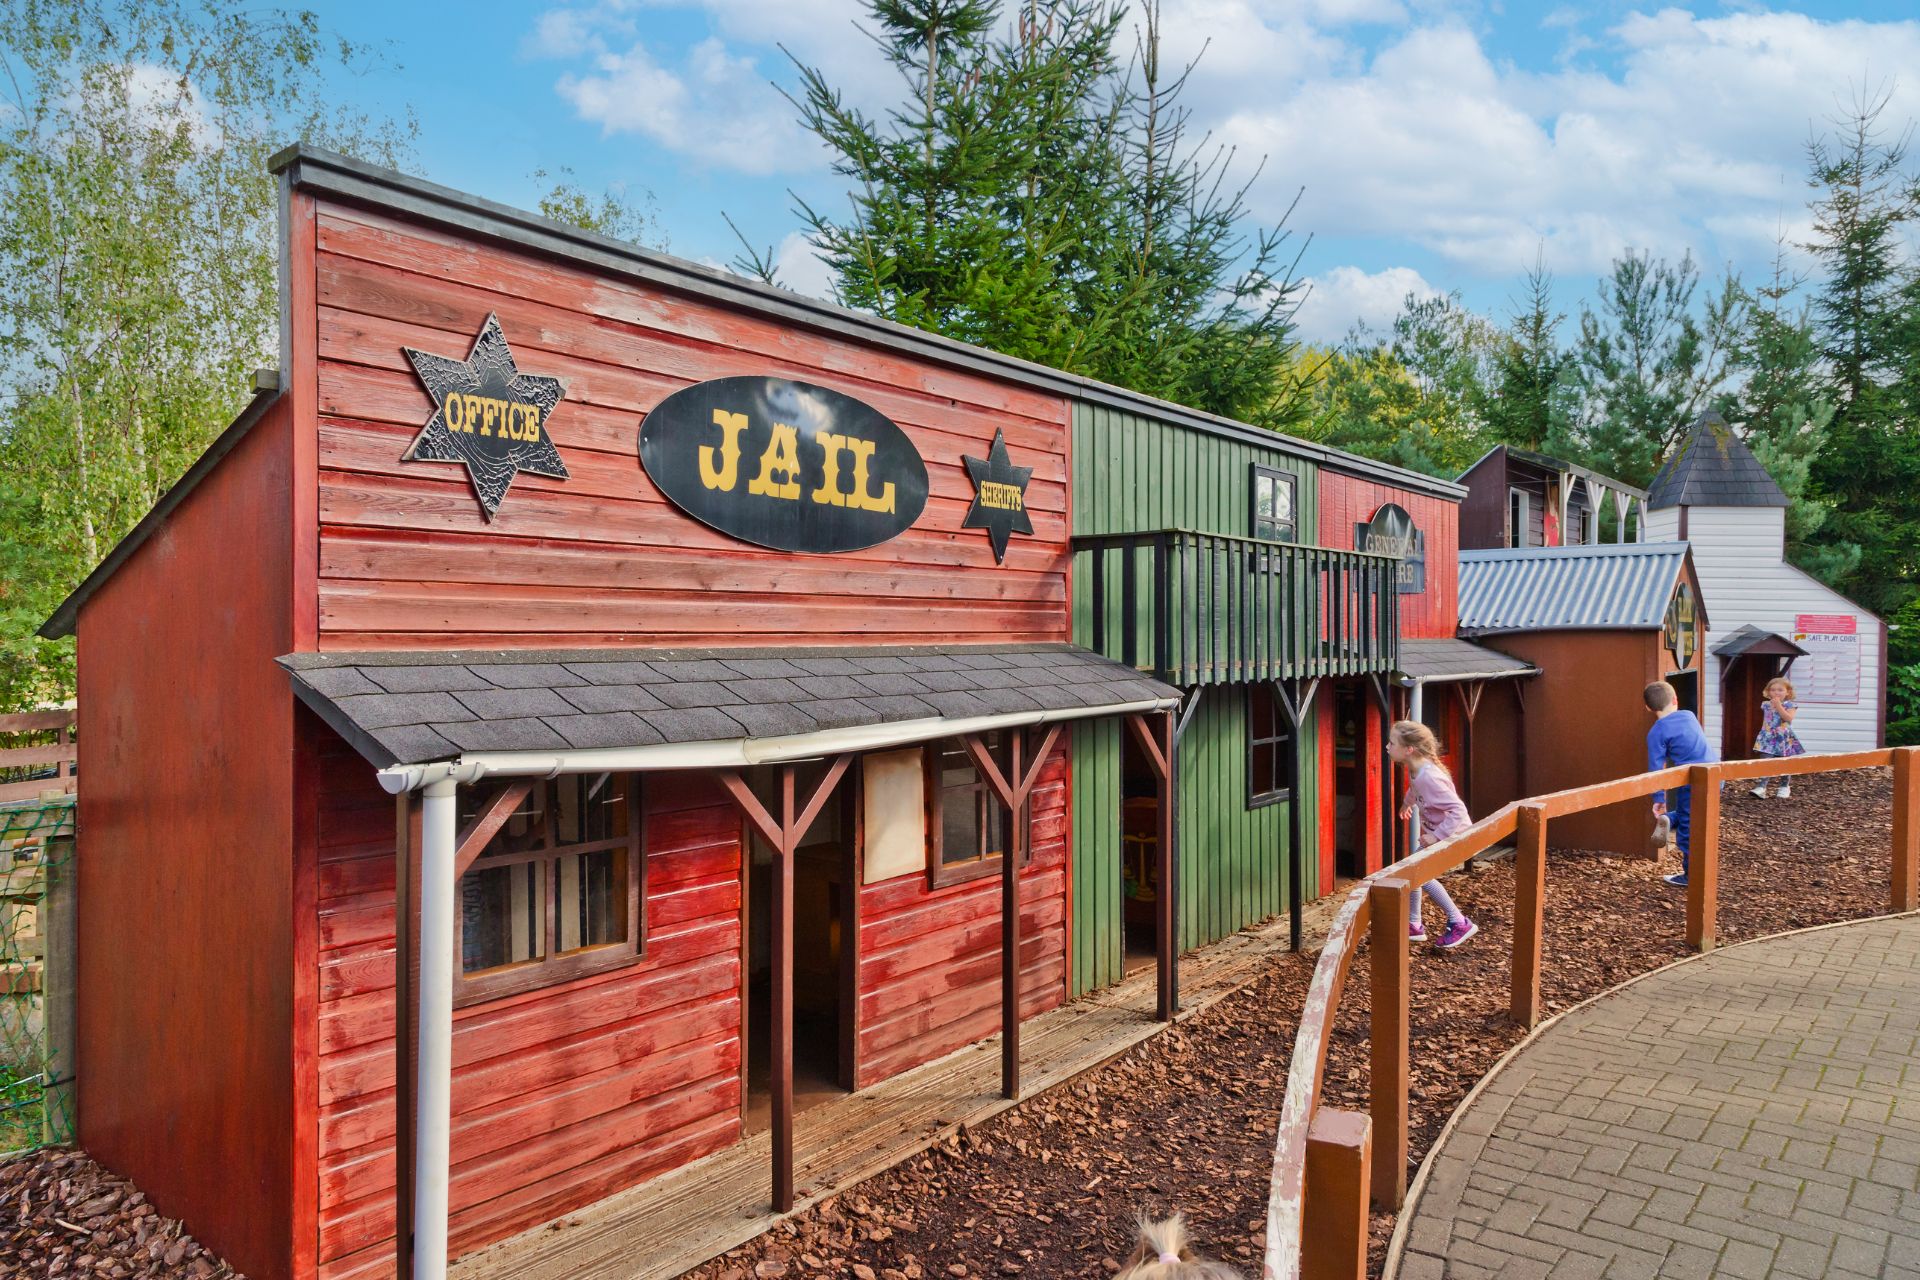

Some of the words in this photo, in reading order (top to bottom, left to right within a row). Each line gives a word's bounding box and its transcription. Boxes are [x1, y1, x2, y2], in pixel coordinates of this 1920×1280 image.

[445, 391, 540, 443] OFFICE
[699, 408, 895, 515] JAIL
[981, 480, 1022, 512] SHERIFFS
[1807, 634, 1822, 642] SAFE
[1824, 634, 1839, 642] PLAY
